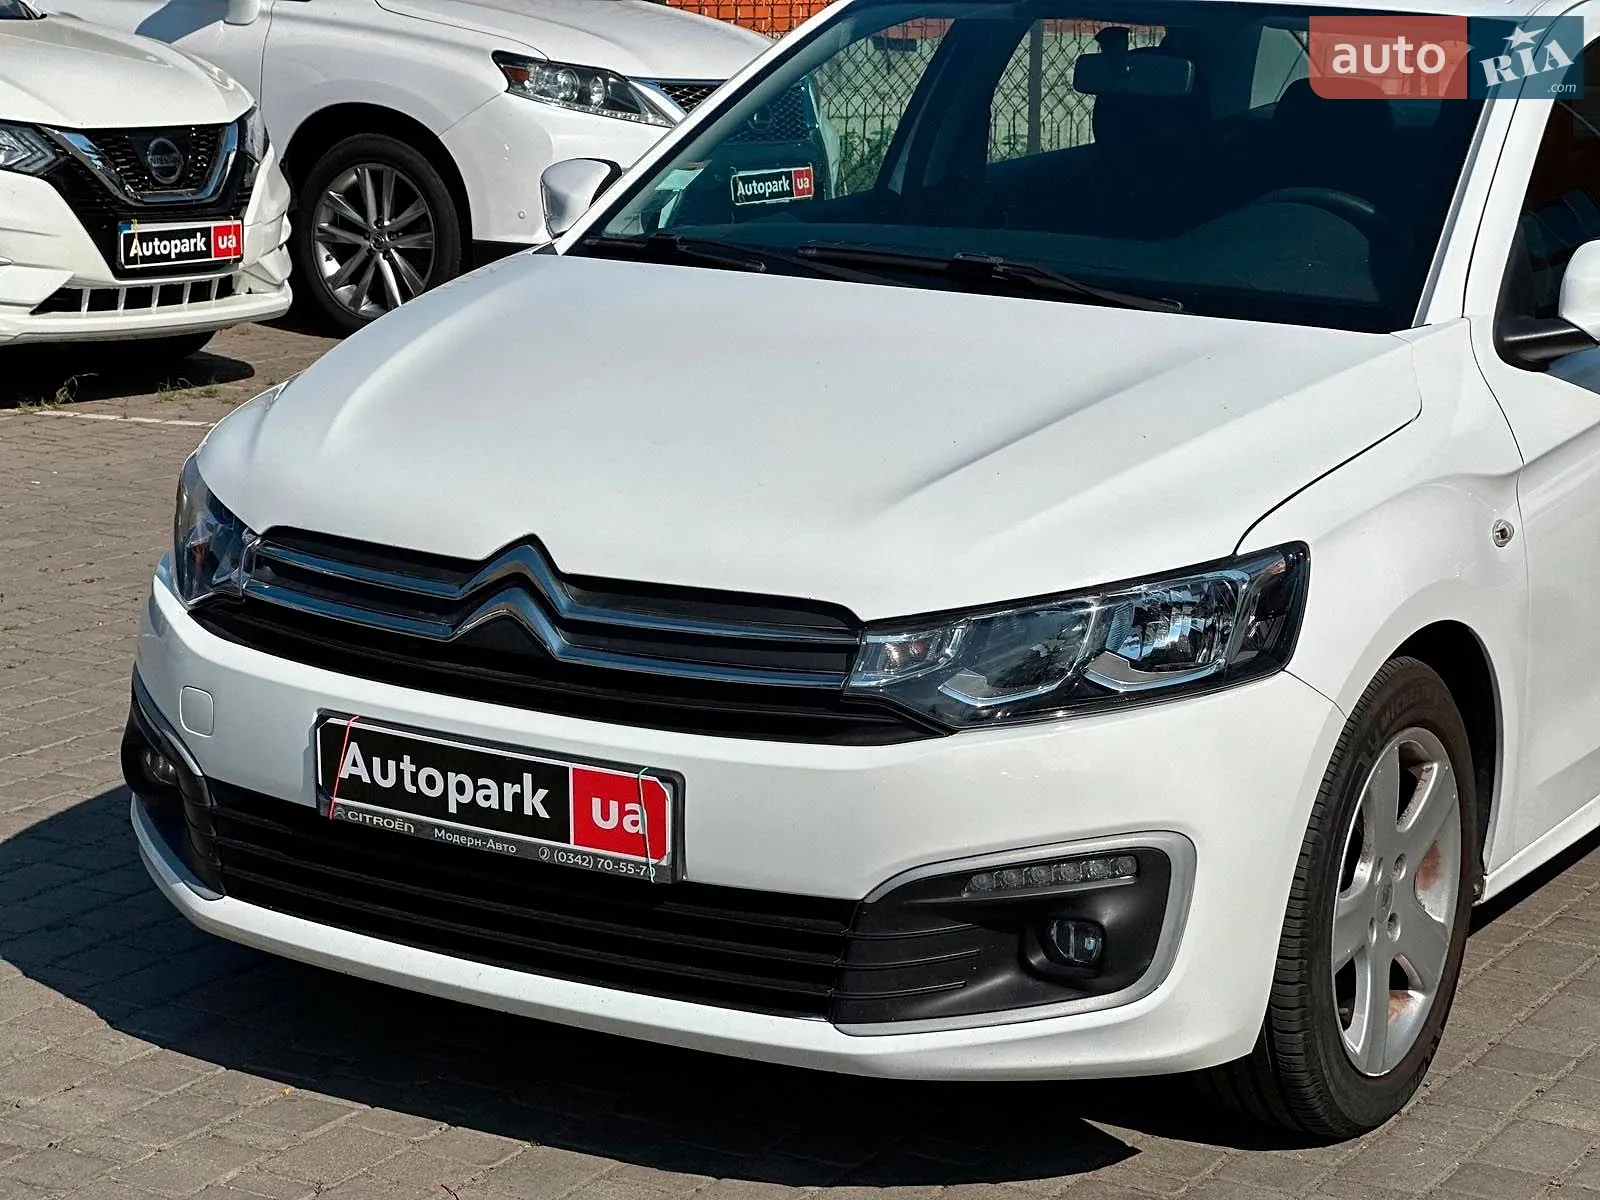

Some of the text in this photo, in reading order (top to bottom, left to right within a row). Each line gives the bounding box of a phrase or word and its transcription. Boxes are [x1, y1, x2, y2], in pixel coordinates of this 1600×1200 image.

[736, 175, 810, 197] Autopark ua
[129, 232, 237, 259] Autopark ua
[338, 740, 647, 835] Autopark ua
[434, 828, 517, 853] Модерн-Авто
[554, 849, 594, 869] (0342)
